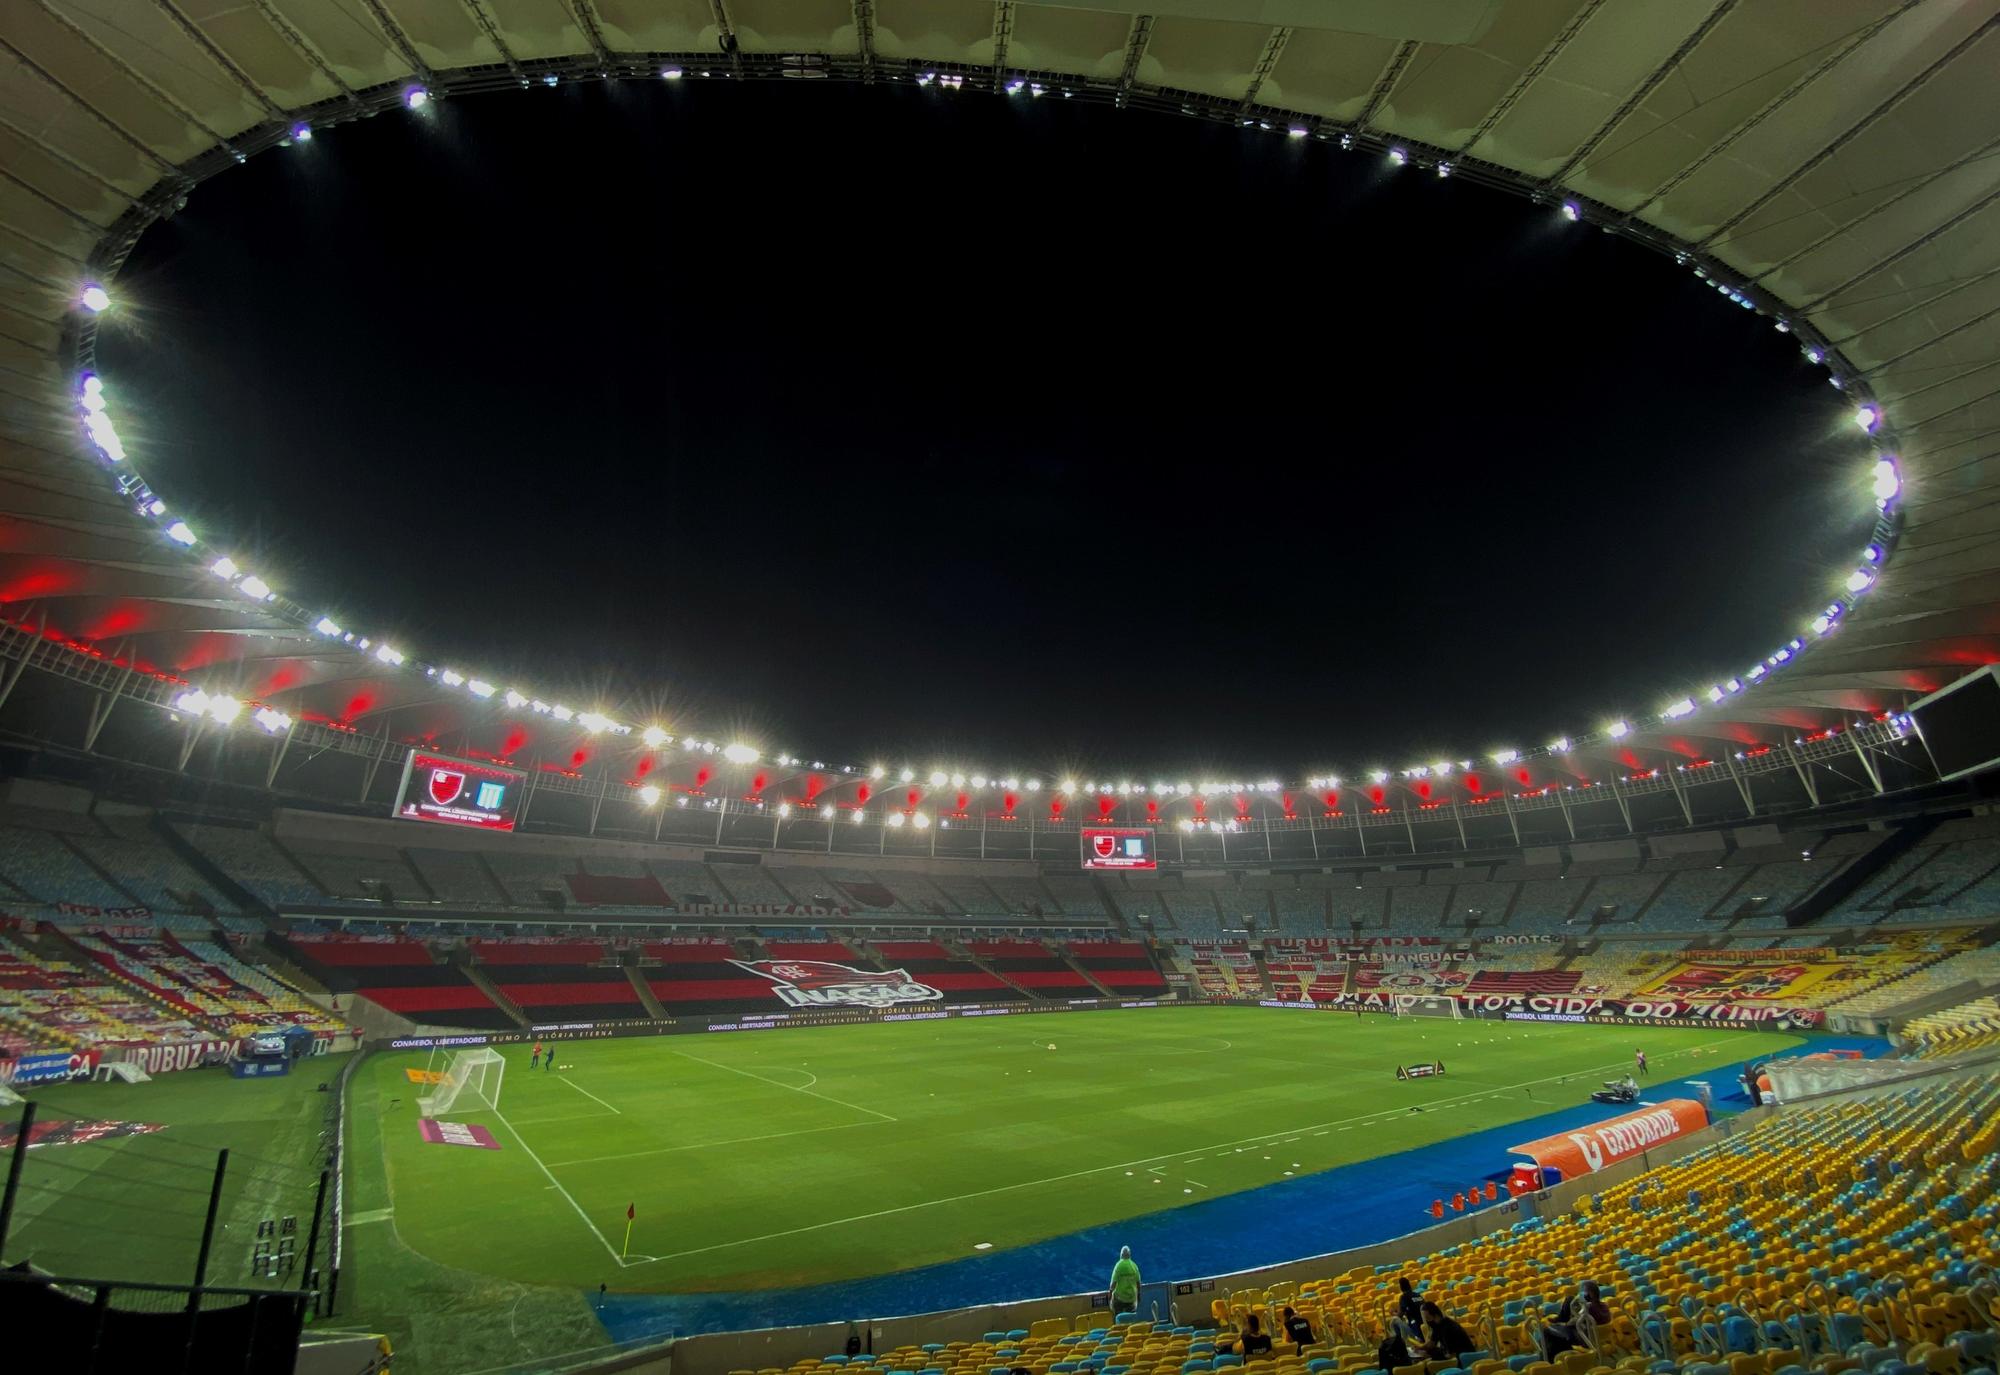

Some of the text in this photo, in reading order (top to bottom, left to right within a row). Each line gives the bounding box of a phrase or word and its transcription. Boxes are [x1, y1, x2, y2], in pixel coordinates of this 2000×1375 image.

[1494, 935, 1551, 945] ROOTS
[1336, 953, 1368, 961] FLA
[788, 983, 927, 1006] NAÇÃO
[708, 1023, 738, 1031] CONMEBOL
[738, 1021, 775, 1030] LIBERTADORES
[1537, 1013, 1586, 1022] LIBERTADORES
[1588, 1016, 1624, 1024] RUMBO
[1638, 1017, 1650, 1025] LA
[1654, 1018, 1697, 1026] GLORIA
[1702, 1020, 1747, 1028] ETERNA
[392, 1039, 434, 1048] CONMEBOL
[435, 1036, 487, 1046] LIBERTADORES
[492, 1034, 520, 1042] RUMO
[579, 1030, 613, 1038] ETERNA
[1596, 1109, 1680, 1156] GATORADE
